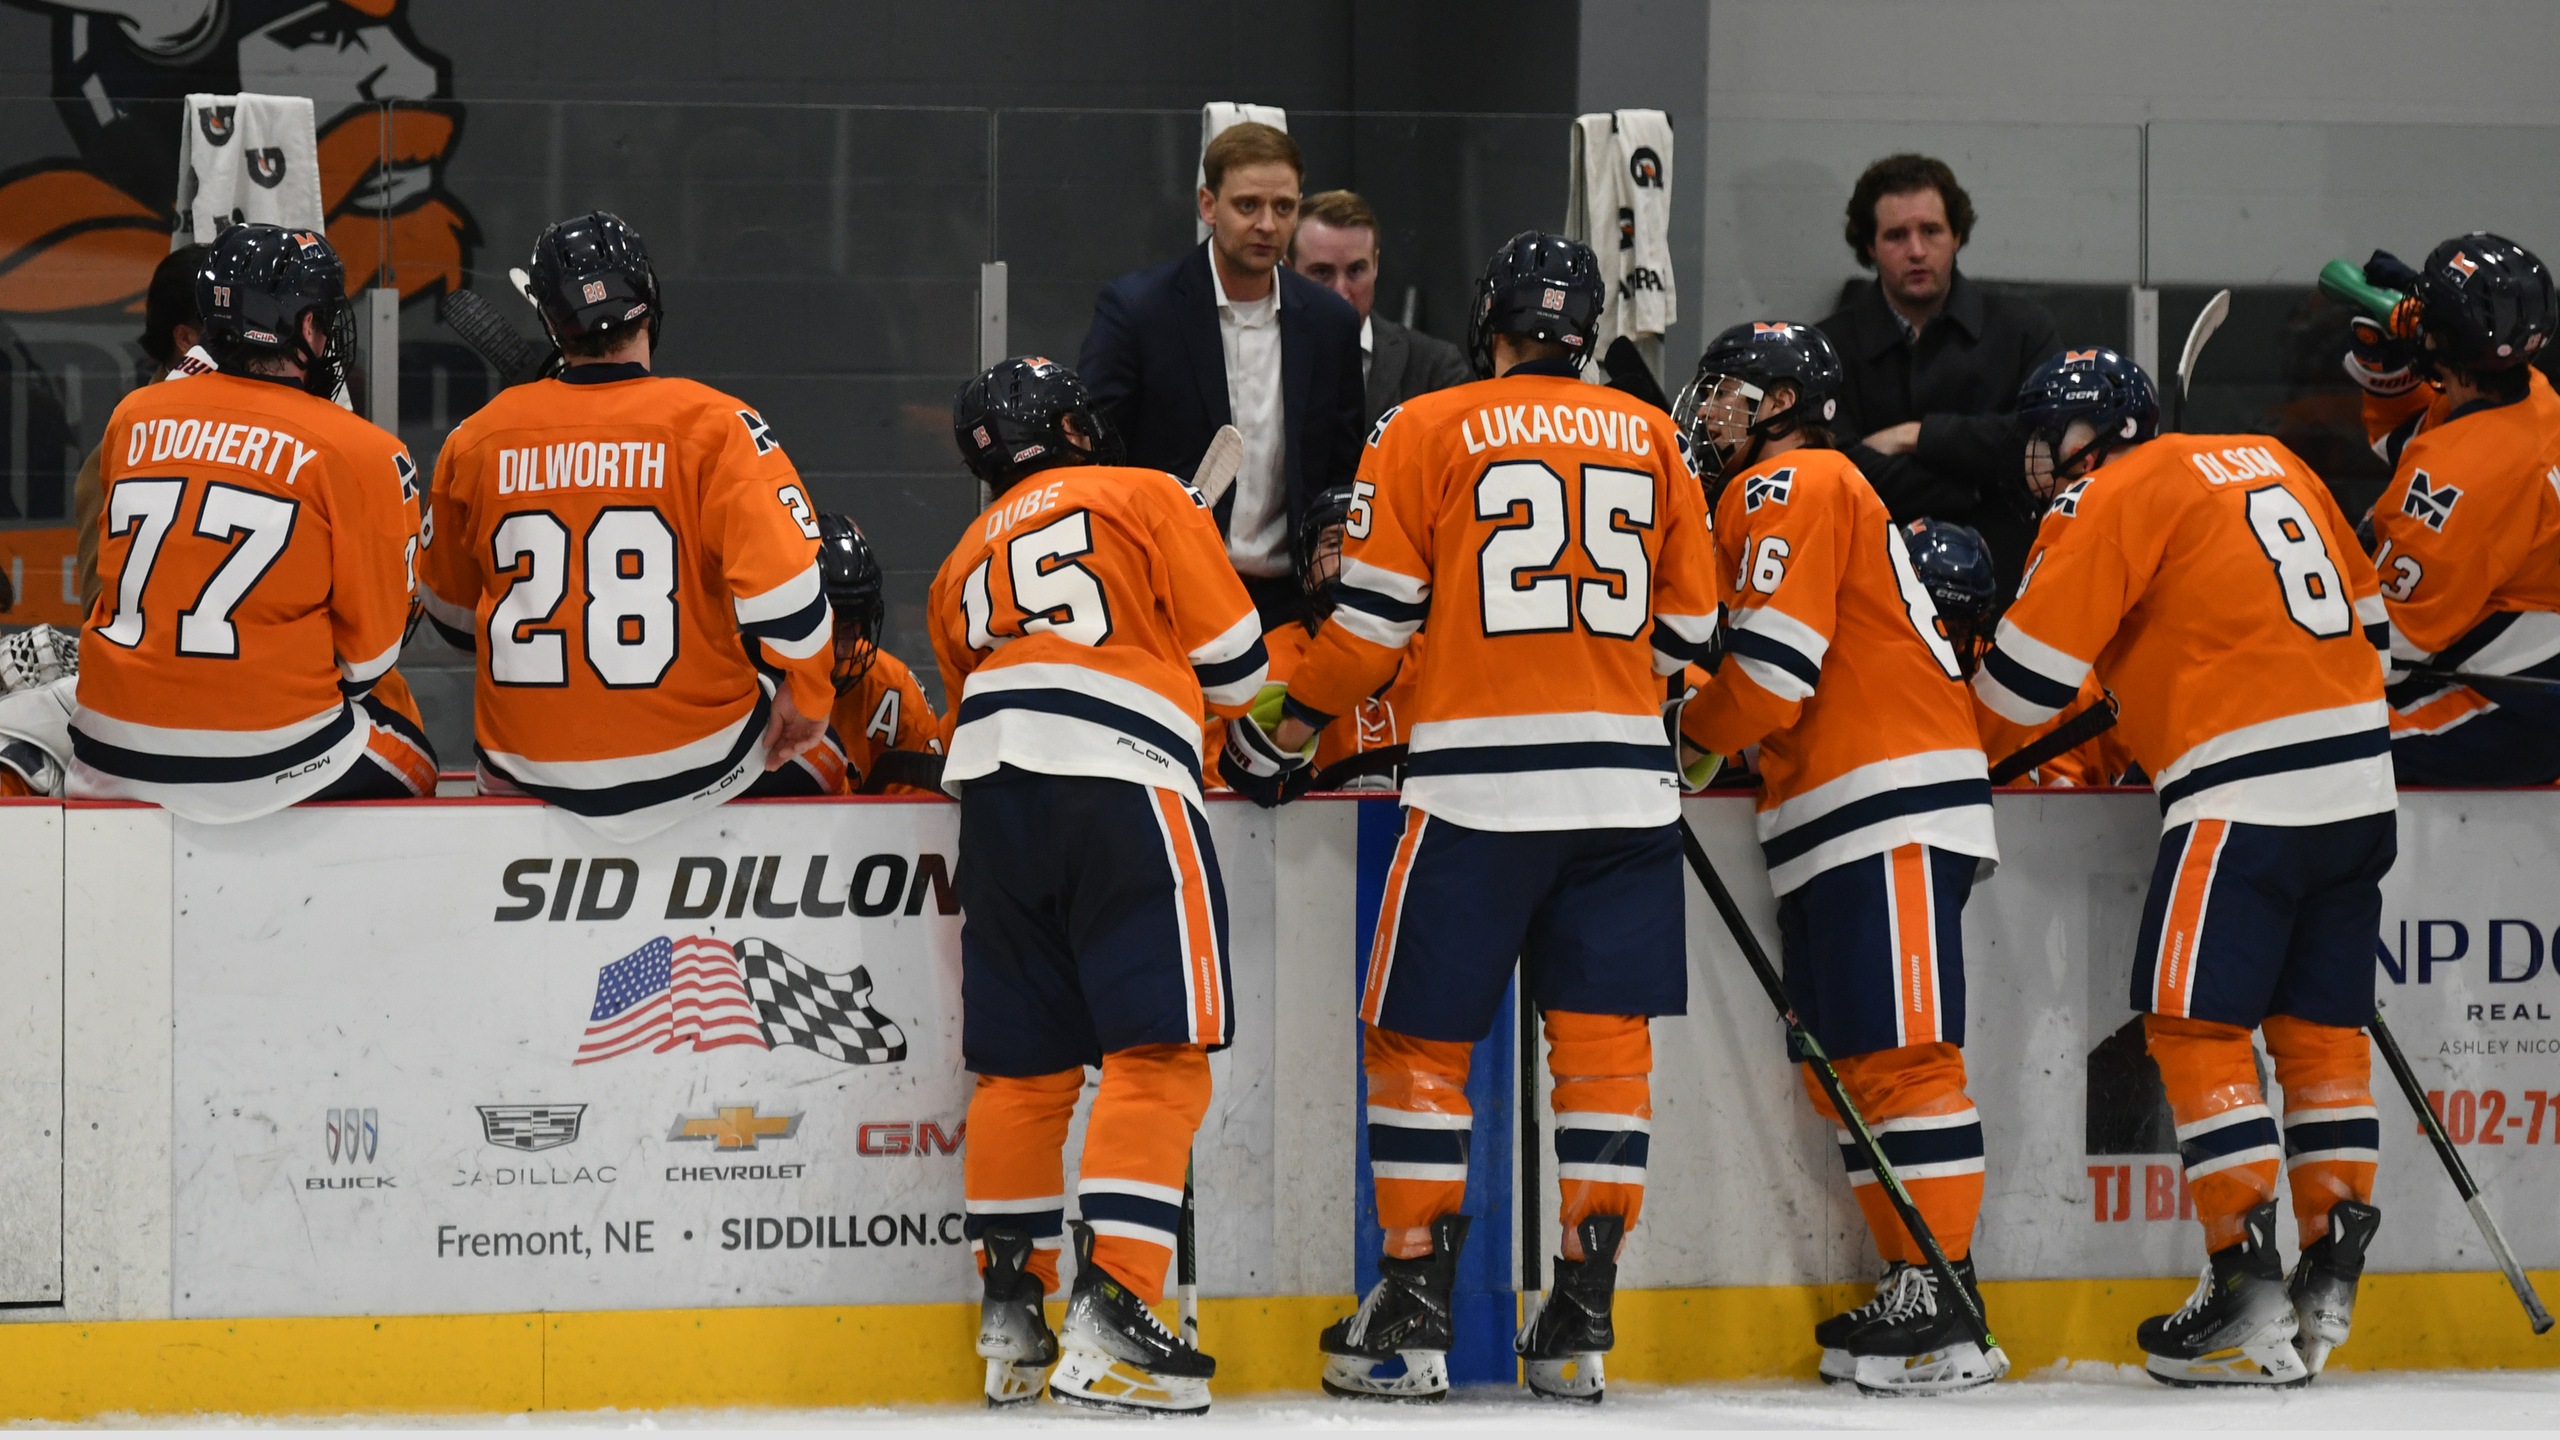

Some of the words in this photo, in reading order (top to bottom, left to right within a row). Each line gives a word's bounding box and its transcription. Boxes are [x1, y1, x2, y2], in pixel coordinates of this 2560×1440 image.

[213, 286, 231, 308] 77
[583, 280, 607, 304] 28
[1542, 287, 1566, 311] 25
[127, 418, 317, 486] O'DOHERTY
[972, 425, 991, 449] 15
[1462, 403, 1650, 458] LUKACOVIC
[499, 441, 666, 496] DILWORTH
[2192, 445, 2286, 486] OLSON
[984, 481, 1064, 543] DUBE
[97, 476, 301, 660] 77
[1475, 459, 1656, 640] 25
[2245, 482, 2354, 642] 8
[486, 505, 680, 690] 28
[961, 509, 1114, 650] 15
[865, 686, 902, 748] A
[275, 755, 331, 785] FLOW
[1116, 736, 1170, 769] FLOW
[692, 765, 745, 801] FLOW
[494, 857, 640, 922] SID
[664, 853, 962, 921] DILLON
[2167, 930, 2184, 989] WARRIOR
[2376, 919, 2470, 985] NP
[2488, 918, 2560, 985] D
[1200, 955, 1213, 1017] WARRIOR
[1911, 954, 1923, 1014] WARRIOR
[2467, 1003, 2551, 1021] REAL
[2439, 1039, 2509, 1056] ASHLEY
[305, 1175, 397, 1190] BUICK
[665, 1163, 806, 1182] CHEVROLET
[2087, 1165, 2131, 1223] TJ
[438, 1223, 592, 1260] Fremont,
[605, 1219, 655, 1254] NE
[721, 1212, 968, 1252] SIDDILLON.C
